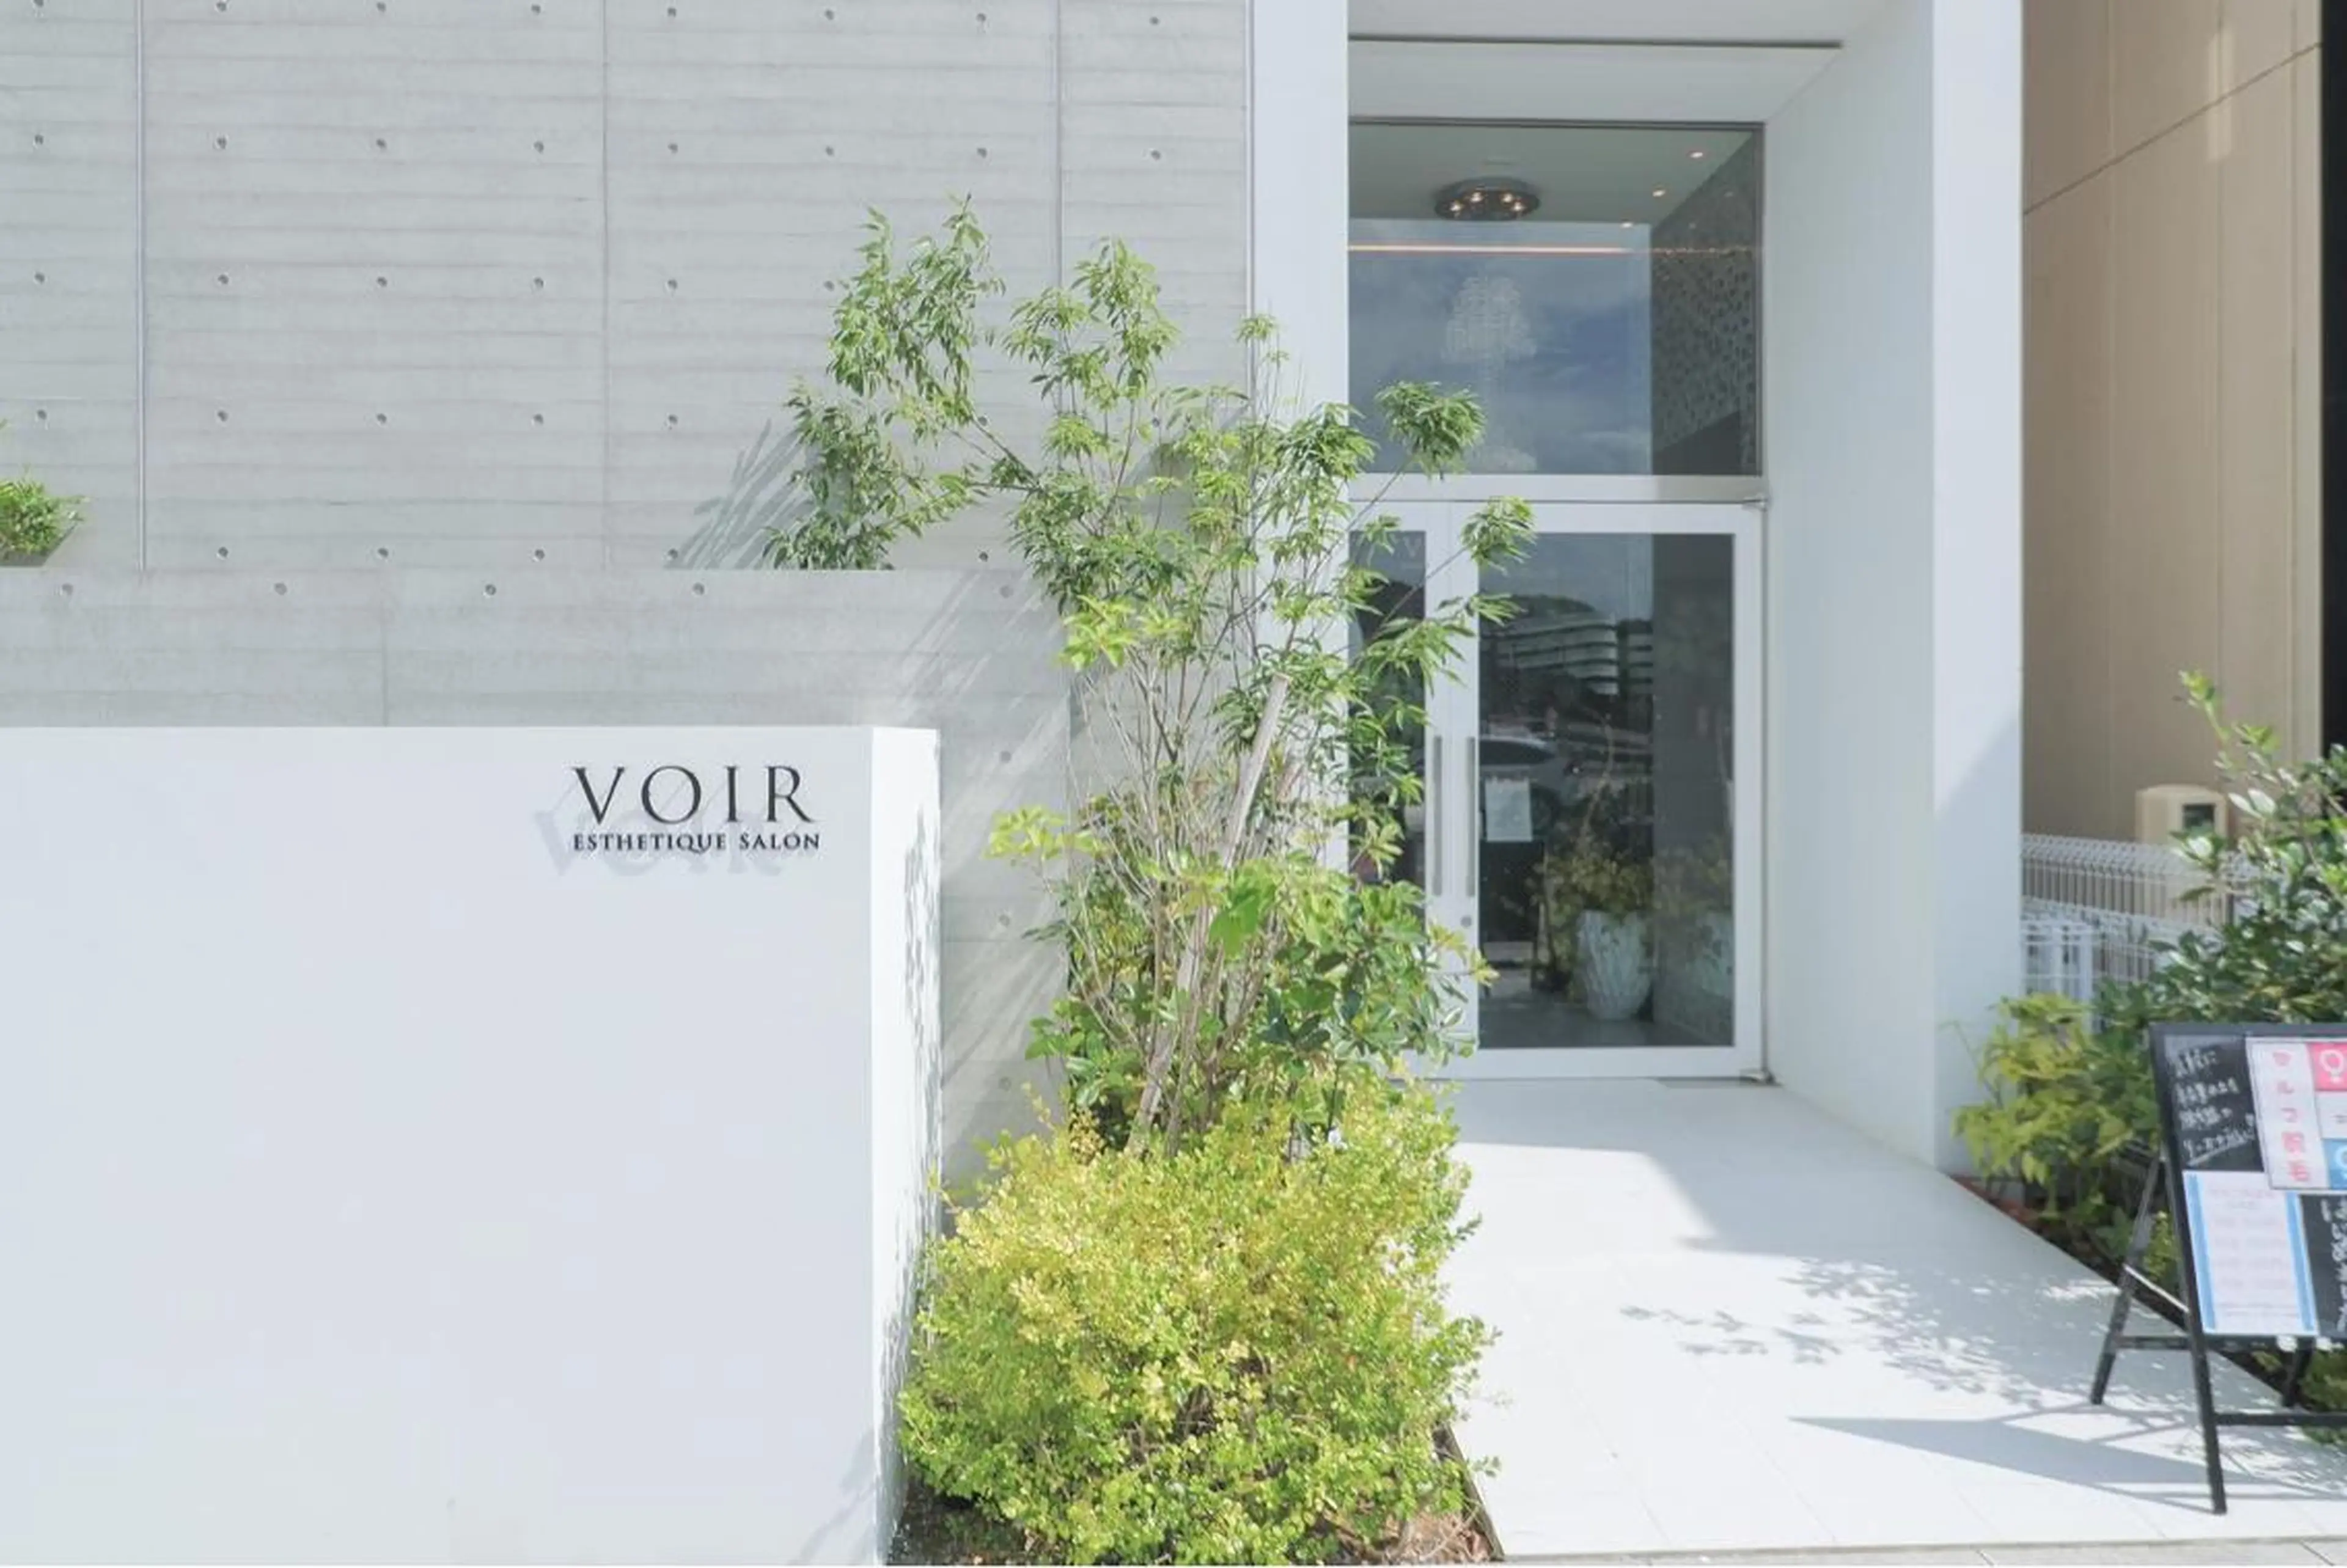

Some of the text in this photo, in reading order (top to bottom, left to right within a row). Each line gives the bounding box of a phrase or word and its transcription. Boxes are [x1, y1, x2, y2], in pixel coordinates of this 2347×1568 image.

[573, 766, 814, 825] VOIR
[574, 832, 819, 855] ESTHETIQUE SALON
